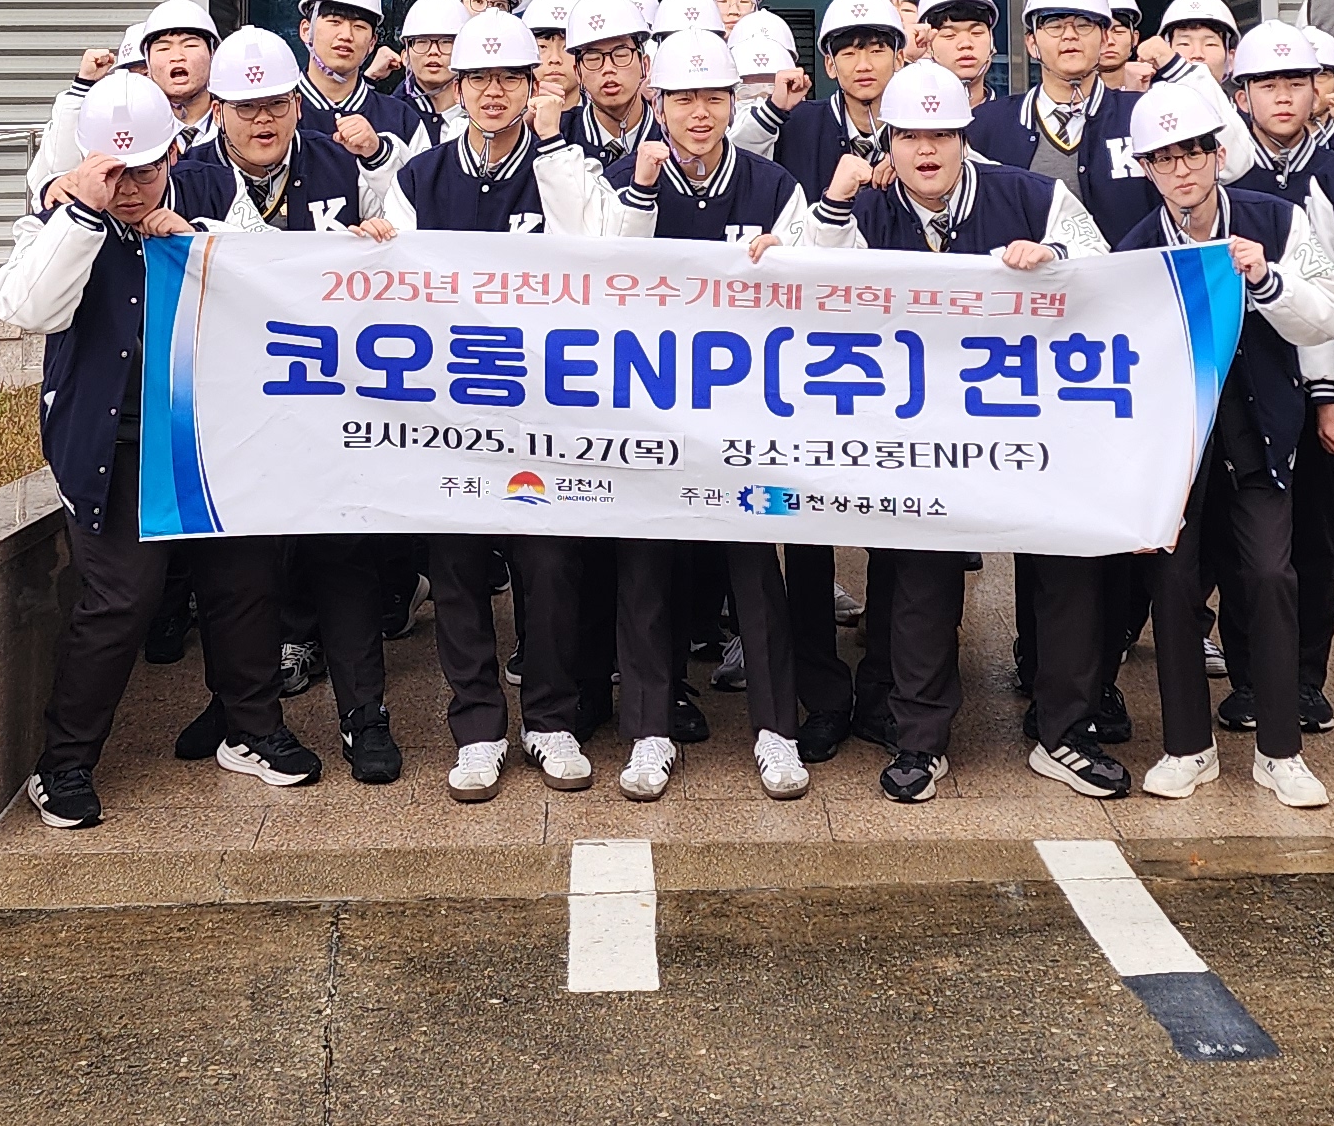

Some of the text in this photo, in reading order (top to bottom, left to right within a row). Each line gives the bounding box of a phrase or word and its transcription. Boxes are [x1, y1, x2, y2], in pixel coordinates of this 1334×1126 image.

[1106, 137, 1147, 179] K
[321, 270, 1068, 318] 2025년 김천시 우수기업체 견학 프로그램
[263, 320, 1141, 420] 코오롱ENP(주) 견학
[721, 437, 1051, 472] 장소:코오롱ENP(주)
[440, 476, 491, 498] 주최:
[554, 477, 613, 494] 김천시
[679, 485, 731, 507] 주관:
[781, 491, 949, 517] 김천상공회의소
